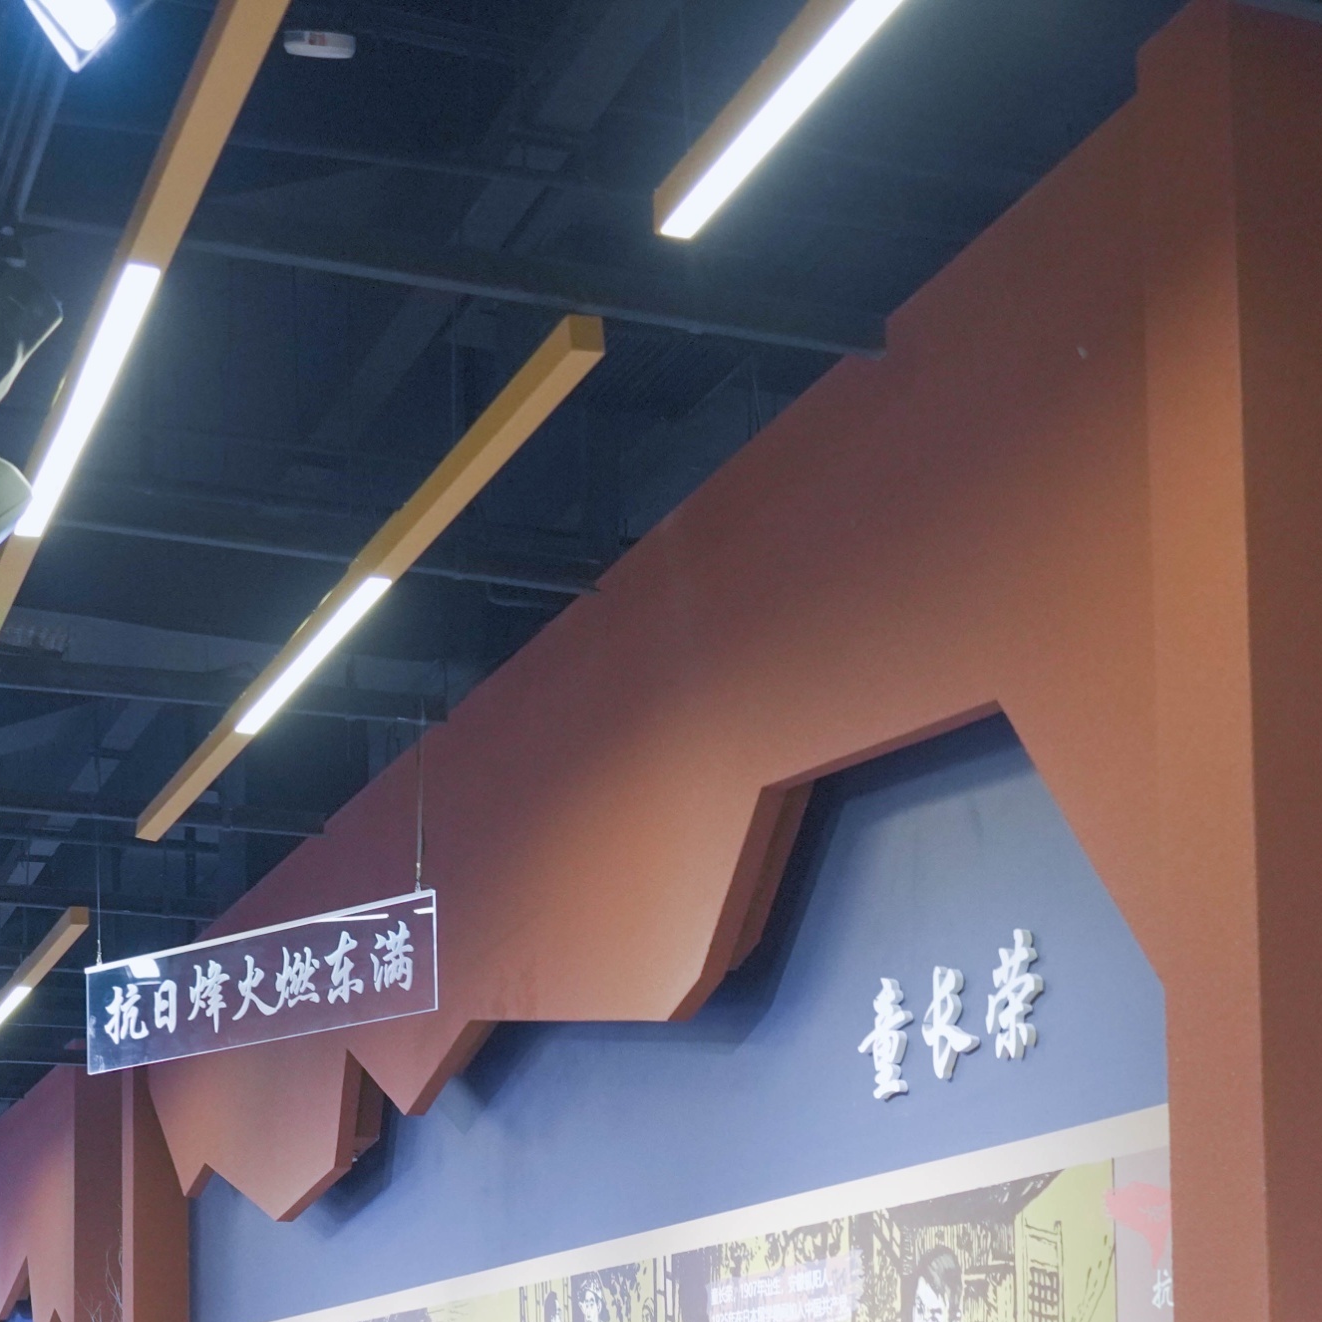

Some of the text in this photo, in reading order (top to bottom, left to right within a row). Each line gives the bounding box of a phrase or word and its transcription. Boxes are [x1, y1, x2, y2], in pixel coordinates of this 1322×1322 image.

[104, 920, 414, 1045] 抗日烽火燃东满
[857, 928, 1044, 1100] 童长荣
